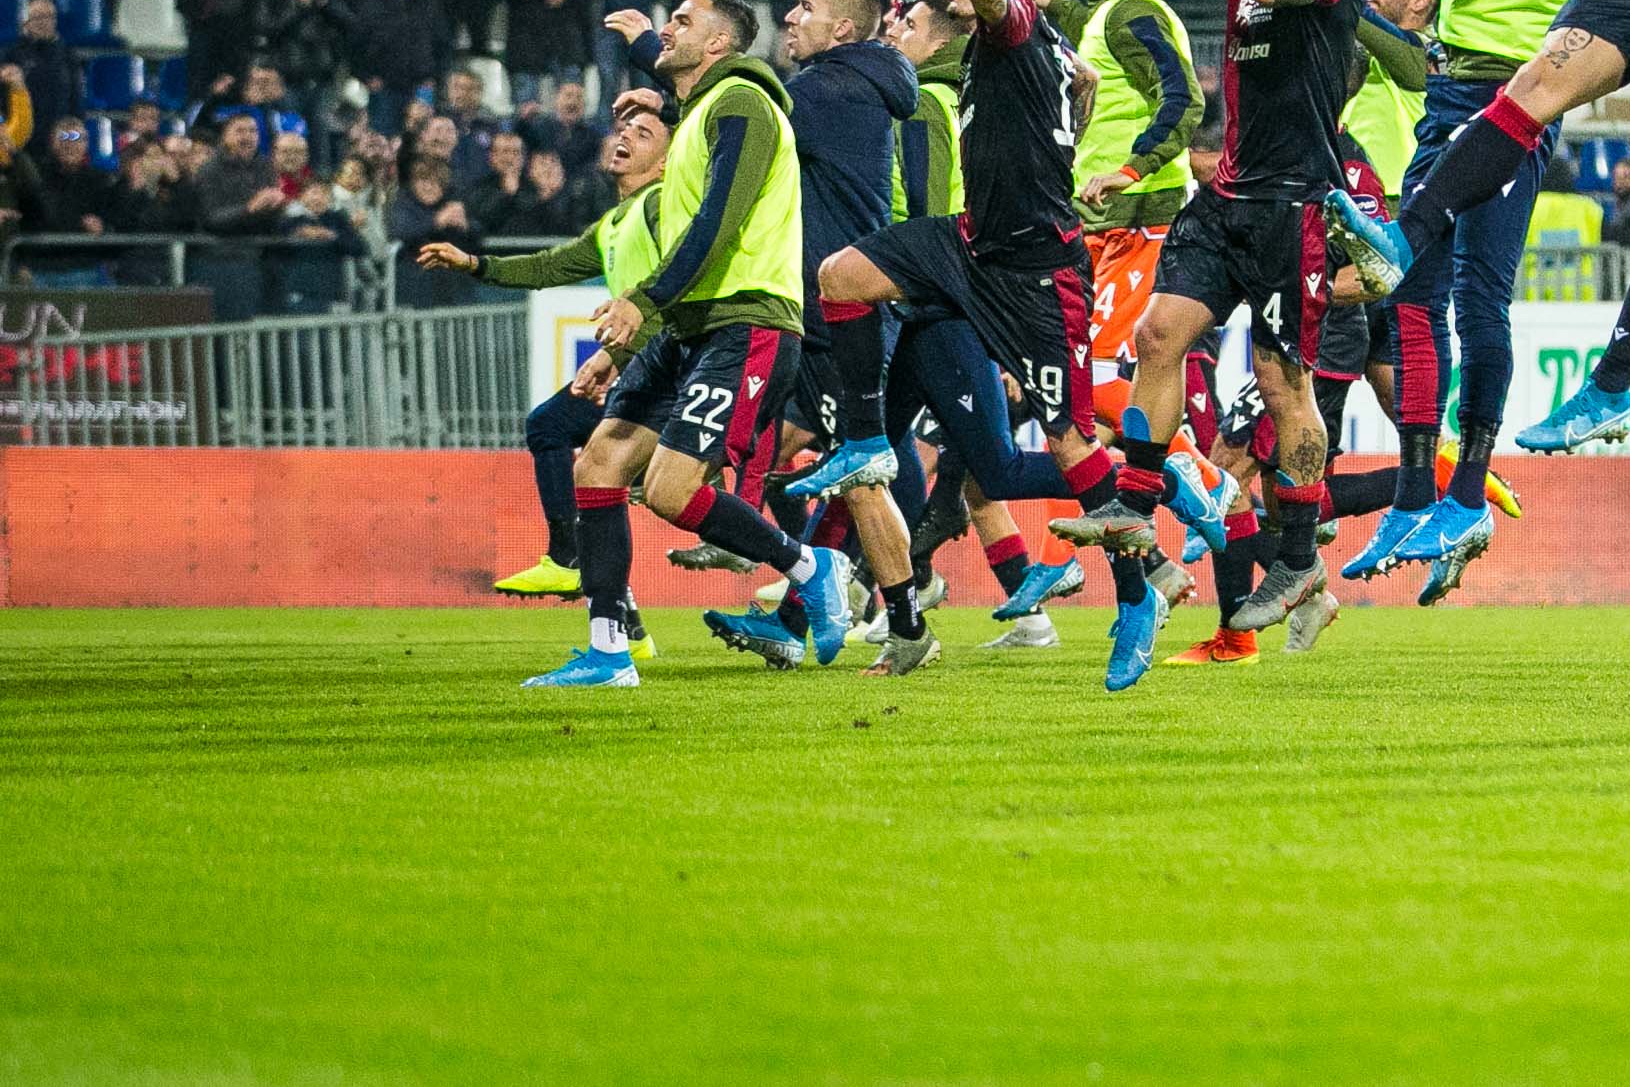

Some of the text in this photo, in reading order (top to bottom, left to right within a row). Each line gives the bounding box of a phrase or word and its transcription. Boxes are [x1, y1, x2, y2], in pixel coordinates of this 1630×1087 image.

[1262, 292, 1284, 335] 4
[1022, 357, 1063, 405] 19
[681, 382, 733, 432] 22
